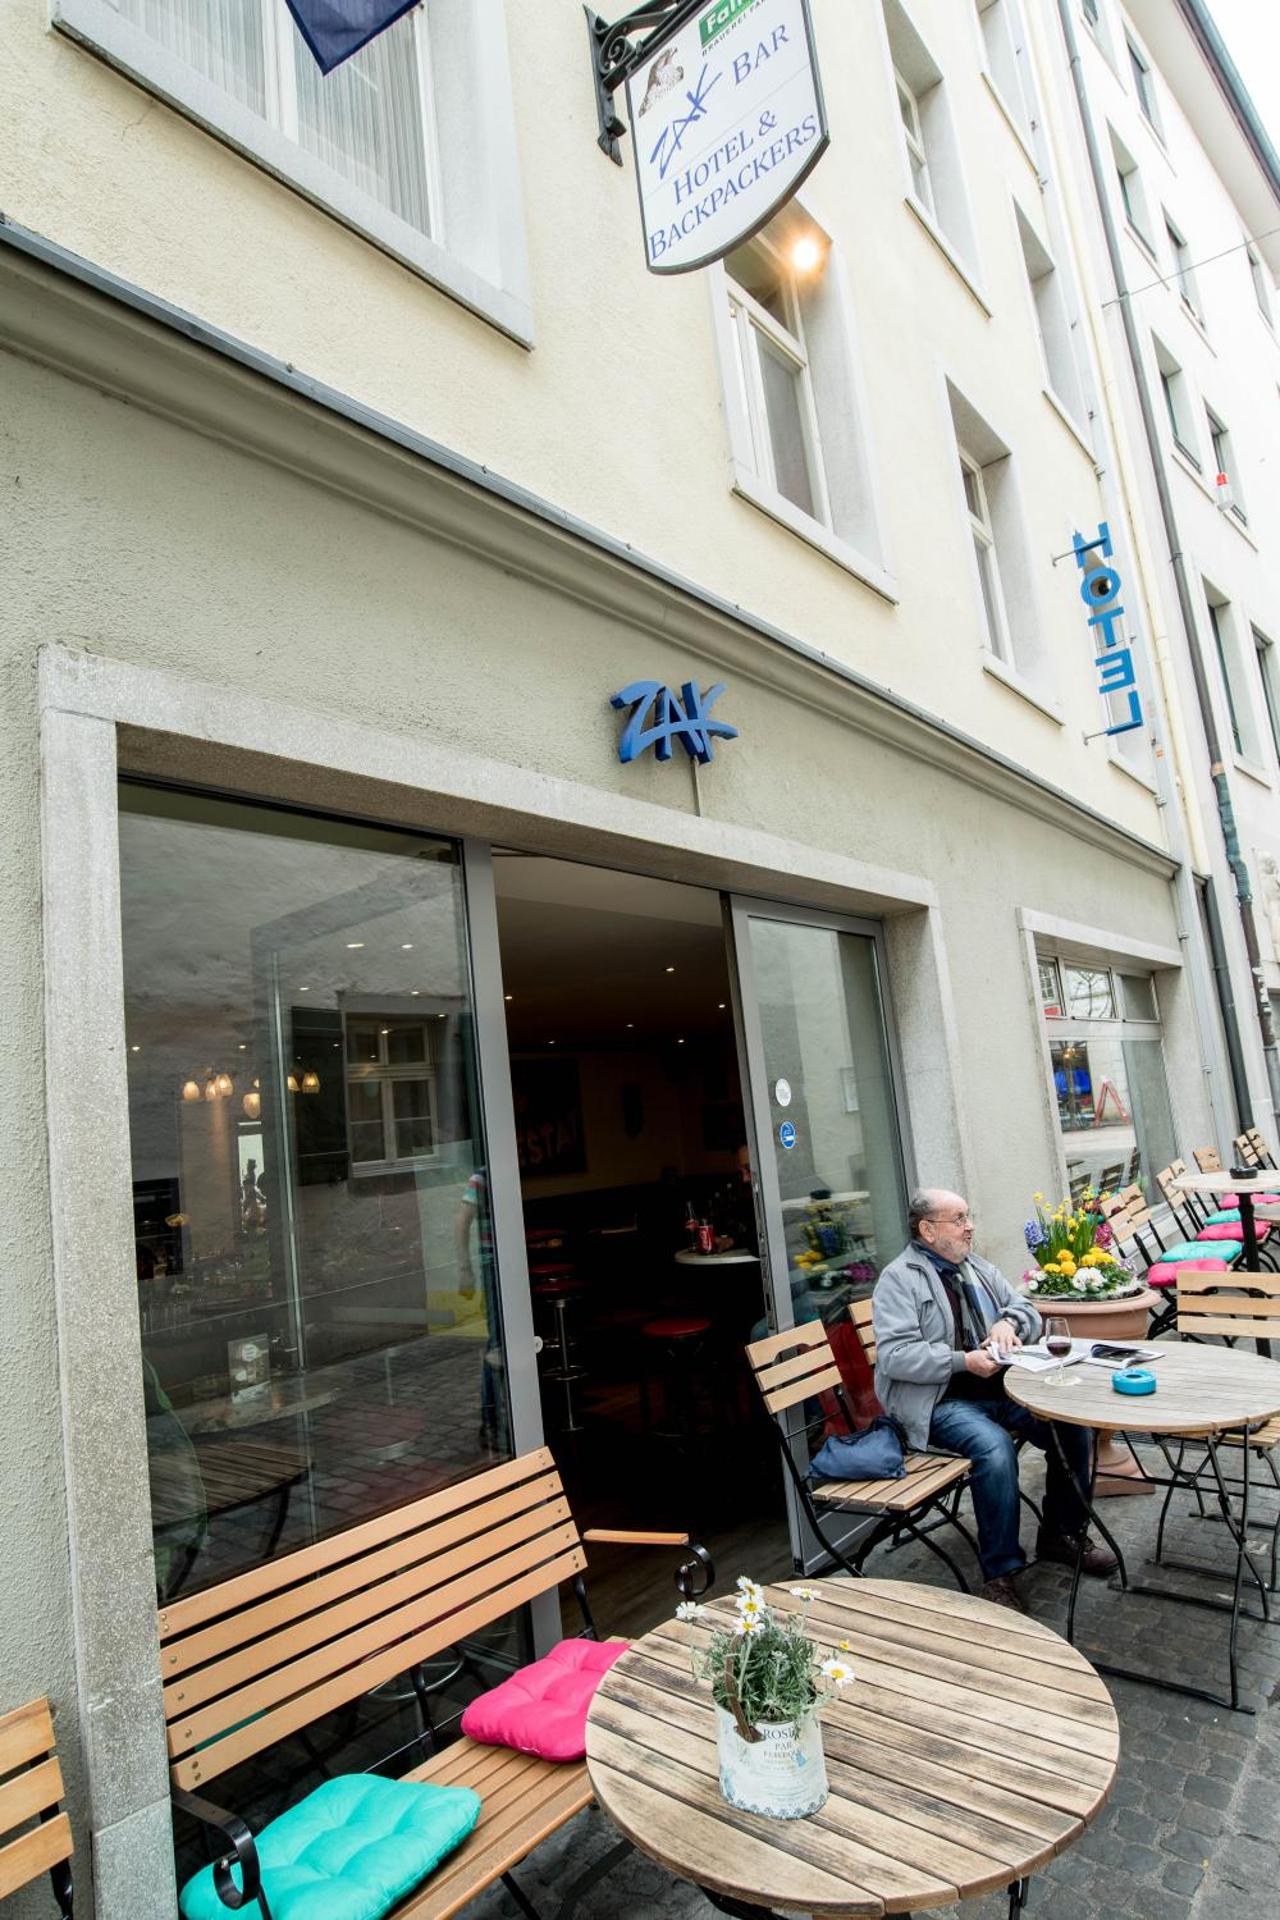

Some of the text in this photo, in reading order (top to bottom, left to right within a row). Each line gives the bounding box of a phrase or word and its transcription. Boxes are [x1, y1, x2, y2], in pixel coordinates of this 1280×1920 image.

[706, 0, 742, 34] Fal
[732, 25, 789, 85] BAR
[649, 115, 816, 261] BACKPACKERS
[673, 110, 777, 204] HOTEL &
[610, 680, 739, 764] ZAK
